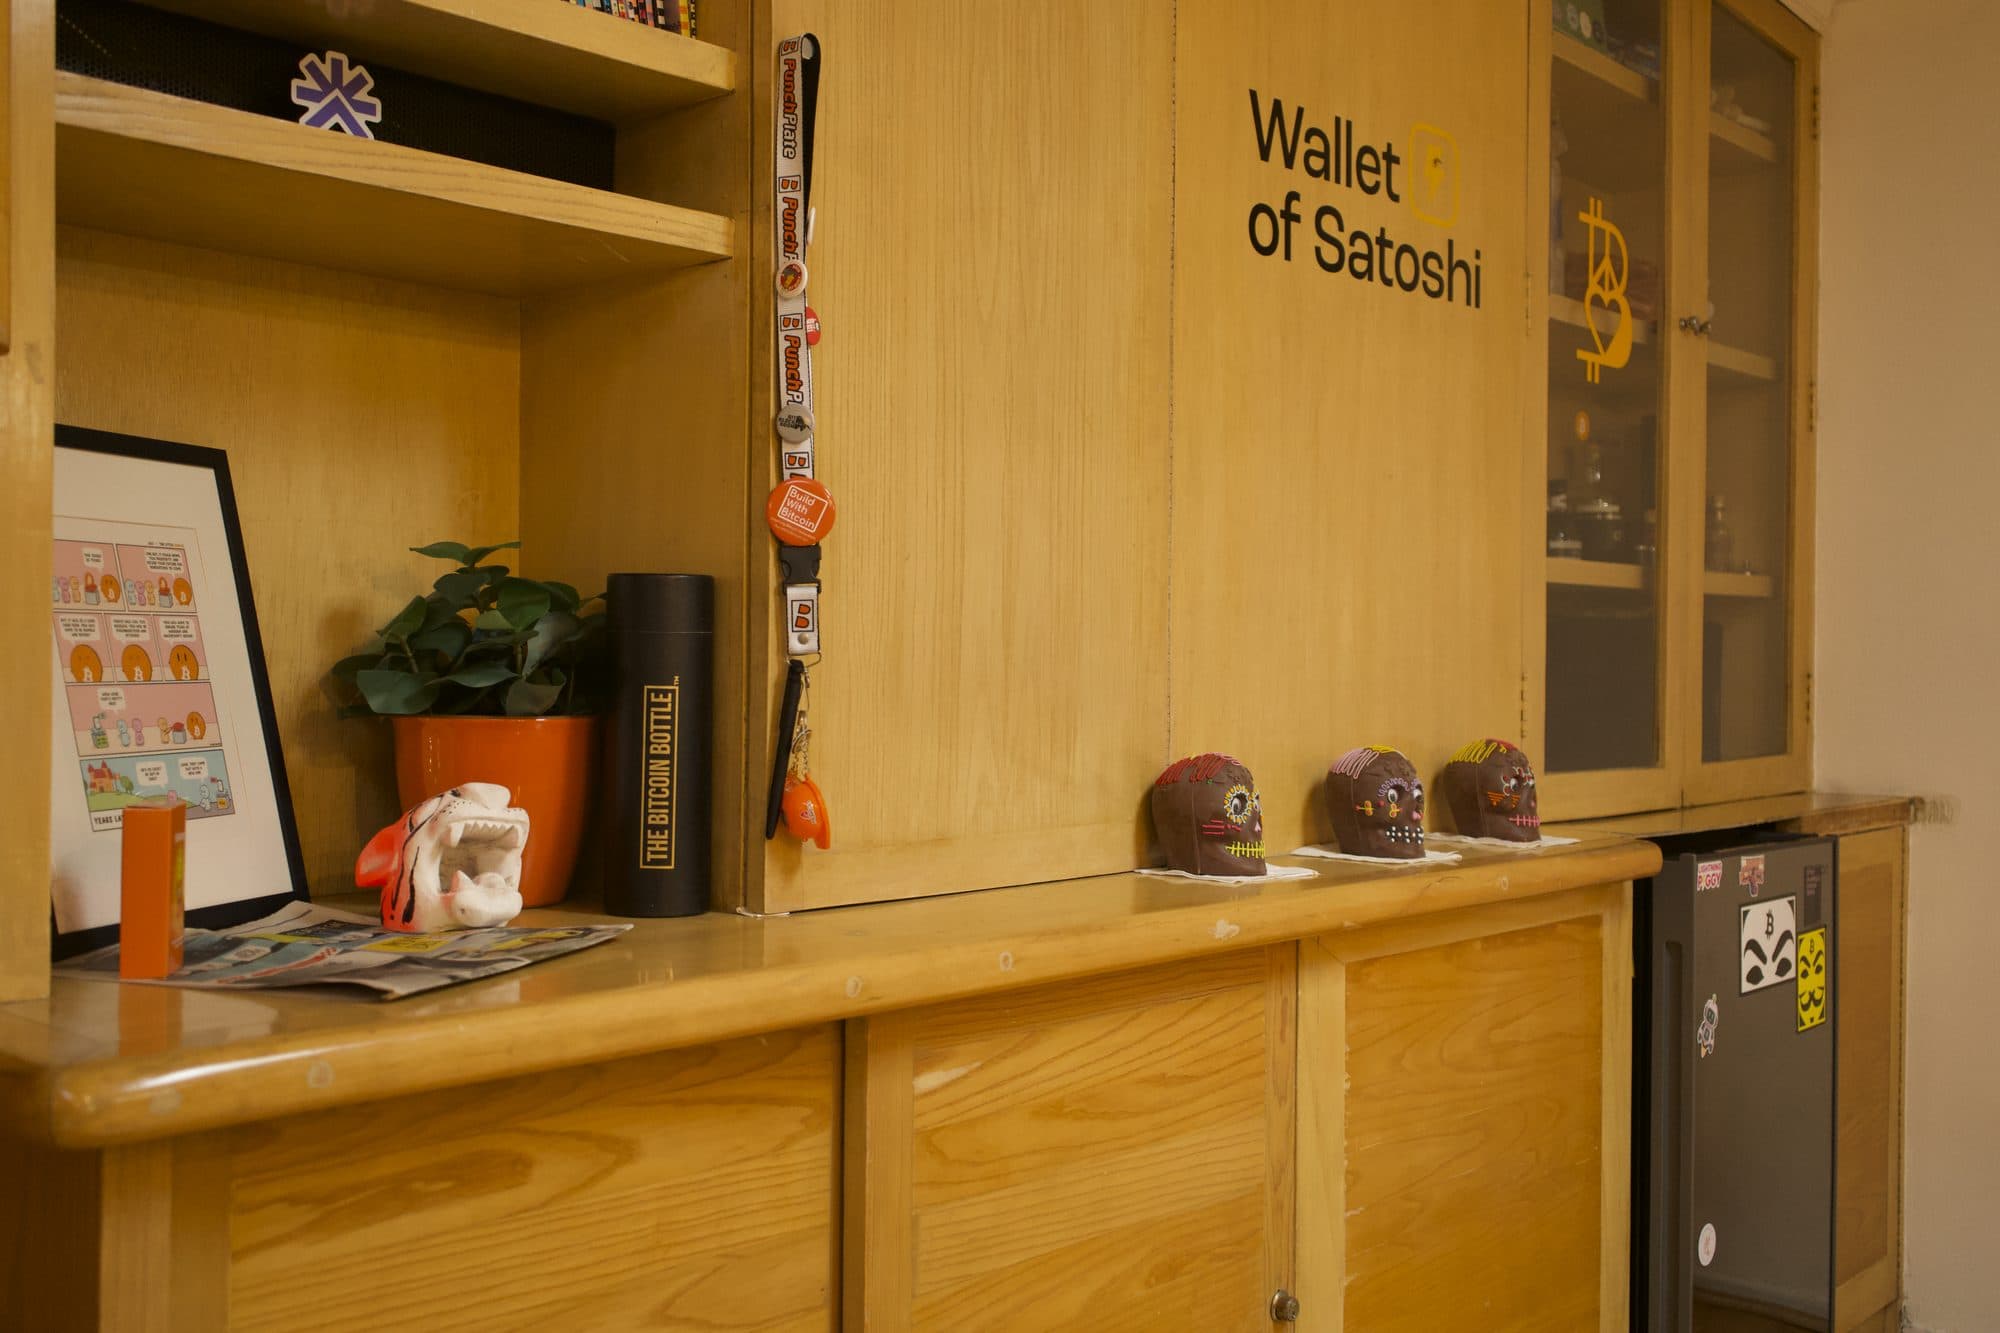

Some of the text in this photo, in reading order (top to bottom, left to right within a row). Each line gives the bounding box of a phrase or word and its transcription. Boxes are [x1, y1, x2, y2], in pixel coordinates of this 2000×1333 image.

[783, 58, 799, 160] PunchPlate
[1248, 88, 1401, 203] Wallet
[1248, 191, 1481, 309] of Satoshi
[780, 507, 816, 531] Bitcoin
[786, 498, 809, 515] With
[788, 487, 817, 506] Build
[649, 692, 672, 755] BOTTLE
[648, 759, 671, 825] BITCOIN
[647, 830, 669, 862] THE
